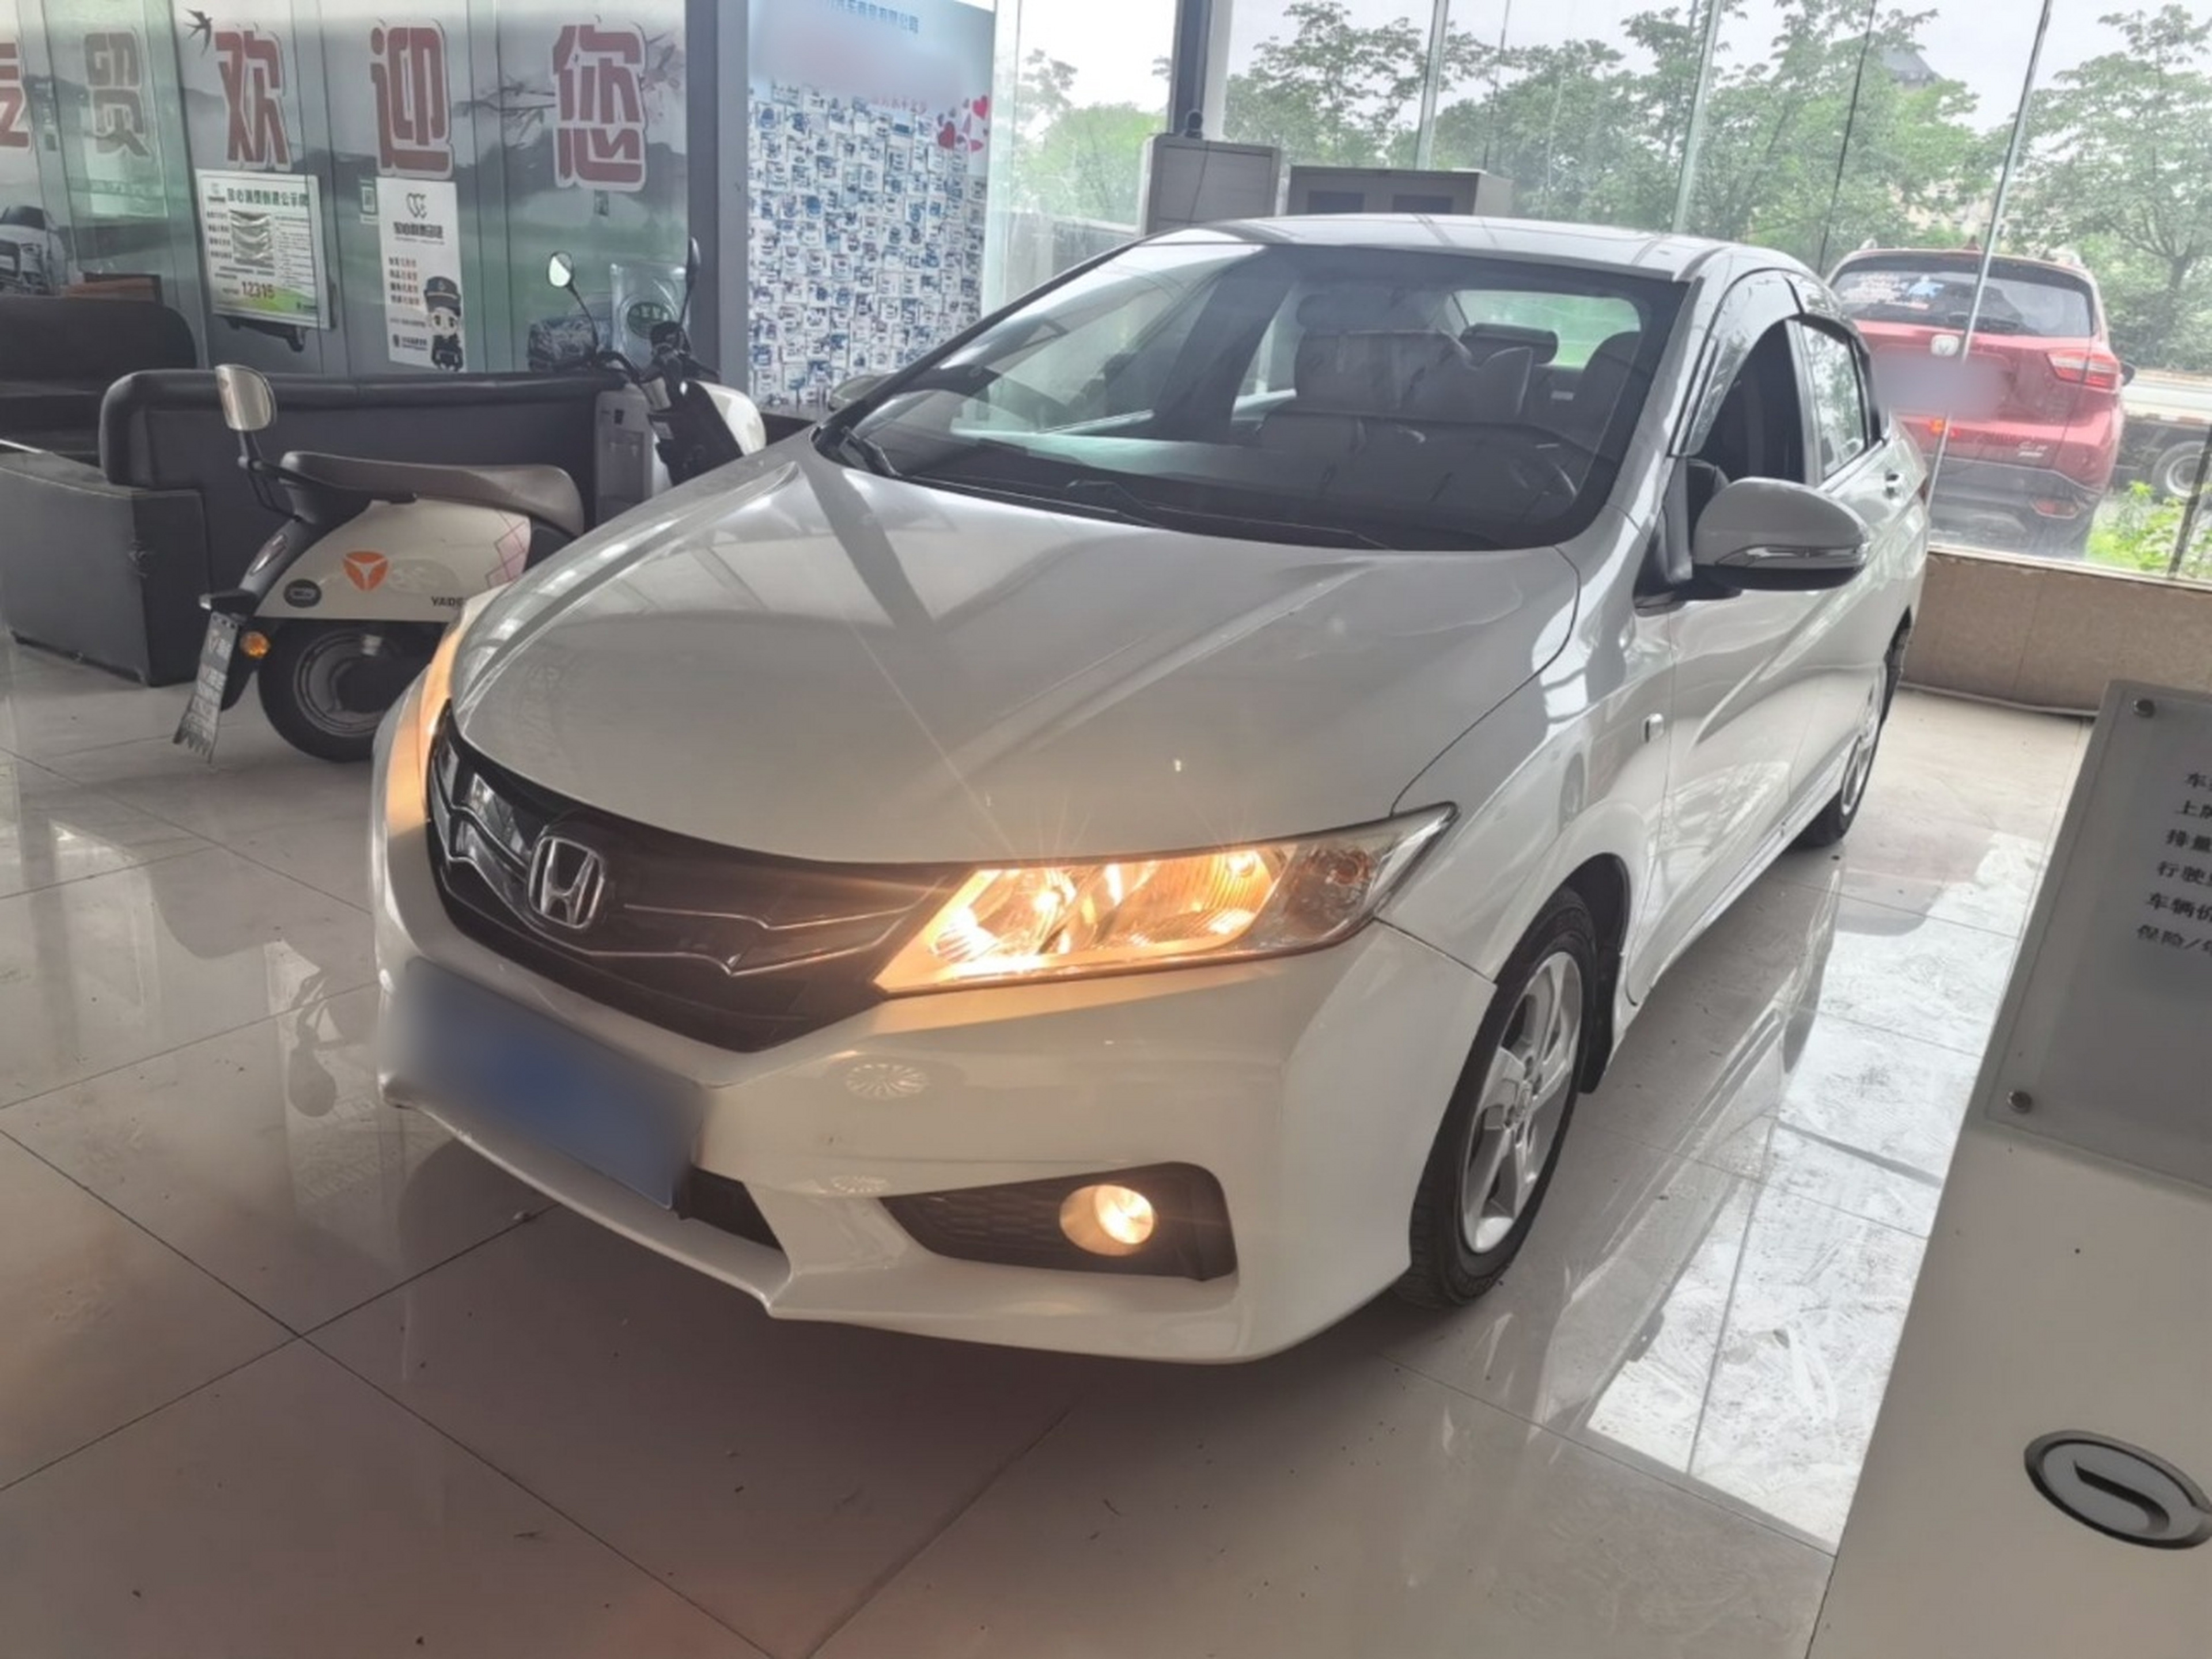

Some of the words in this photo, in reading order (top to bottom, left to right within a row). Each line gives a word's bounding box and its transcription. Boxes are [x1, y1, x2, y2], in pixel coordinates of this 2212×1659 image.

[242, 281, 275, 299] 12315
[2186, 772, 2212, 791] 车
[2157, 861, 2212, 887] 行驶
